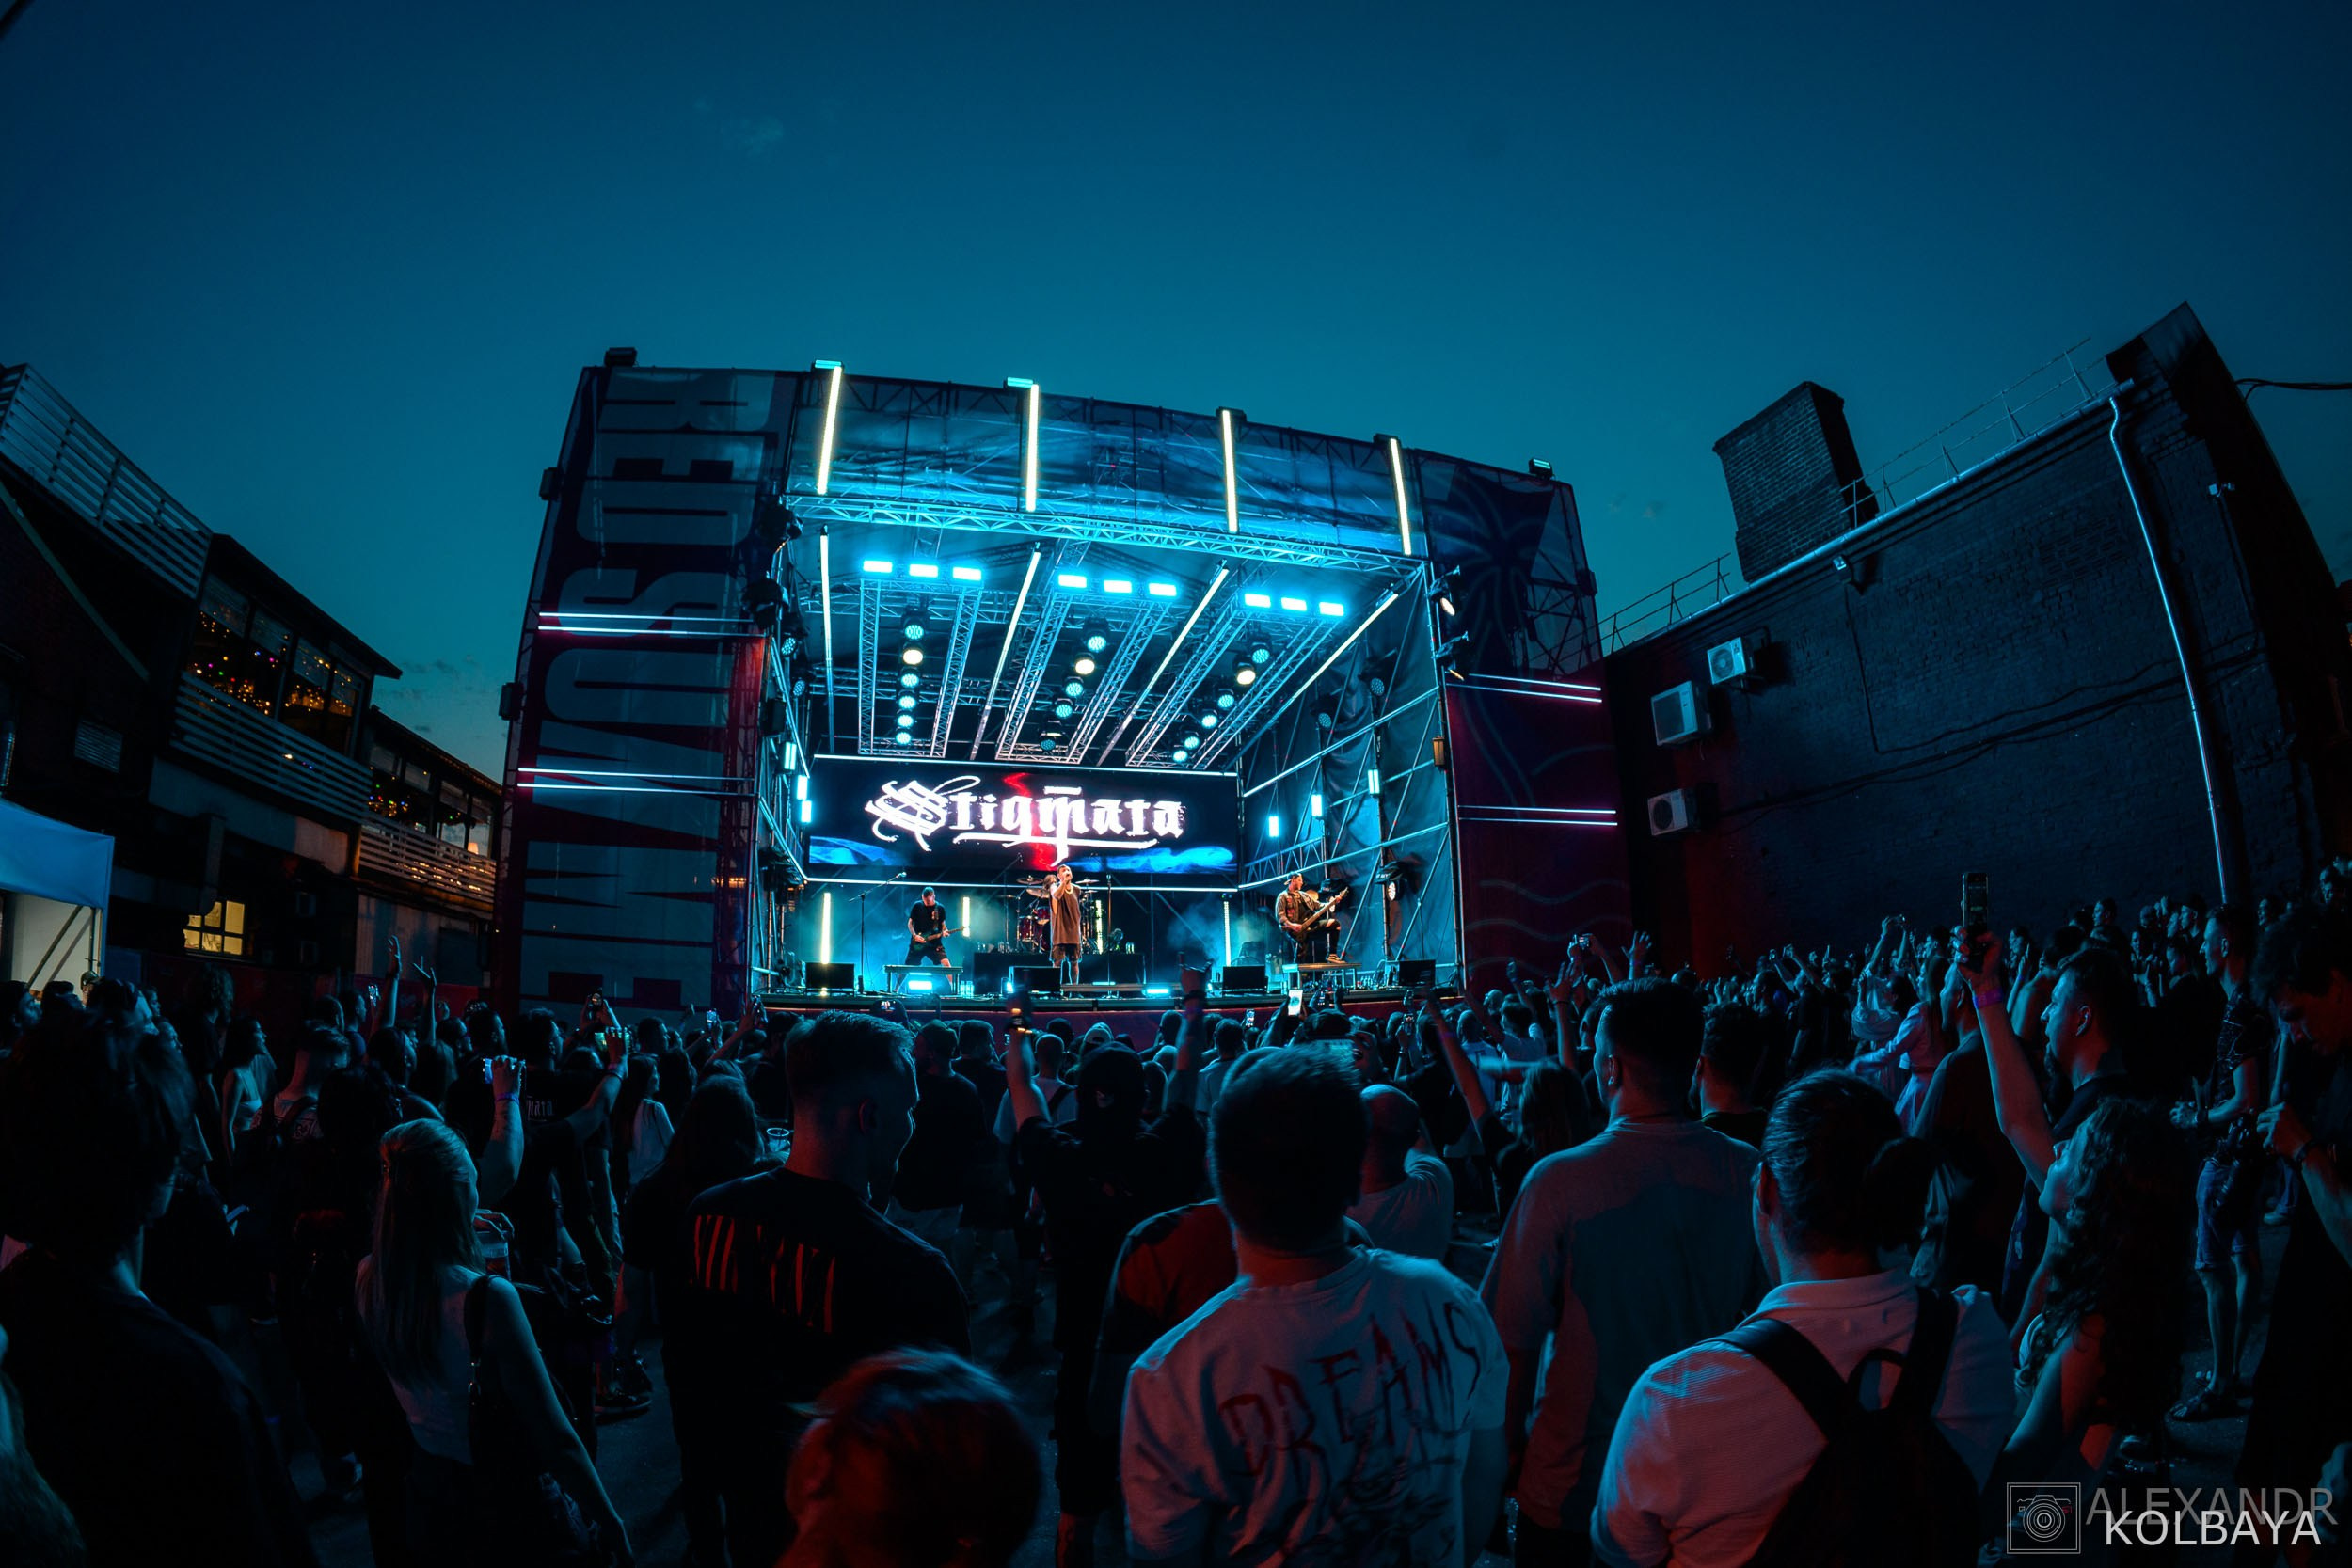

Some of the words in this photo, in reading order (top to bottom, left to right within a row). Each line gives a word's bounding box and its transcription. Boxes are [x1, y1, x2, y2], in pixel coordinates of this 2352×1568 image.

[575, 370, 779, 546] RED
[865, 775, 1187, 866] Stigmata
[1218, 1289, 1481, 1505] DREAMS
